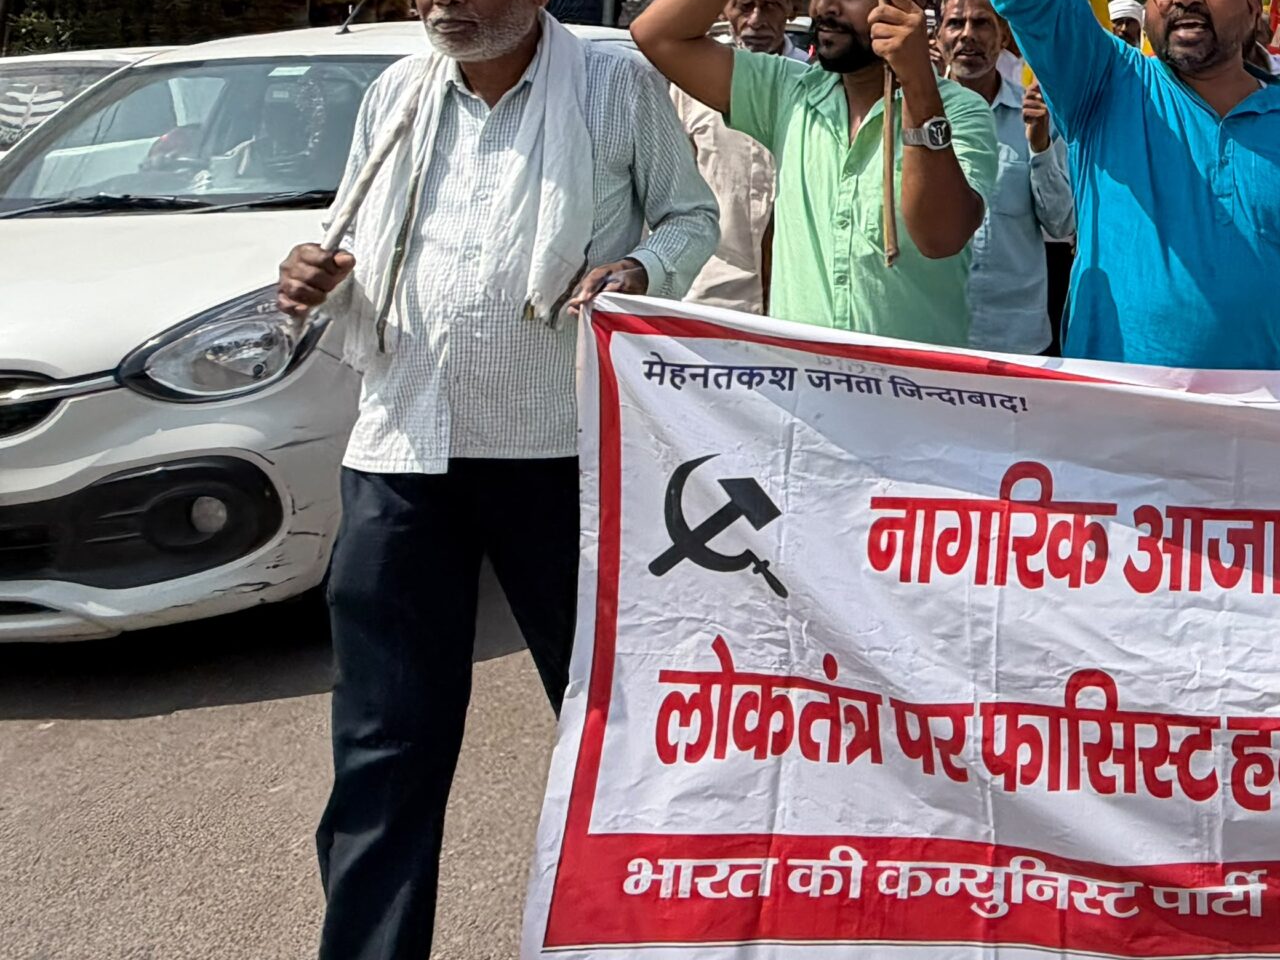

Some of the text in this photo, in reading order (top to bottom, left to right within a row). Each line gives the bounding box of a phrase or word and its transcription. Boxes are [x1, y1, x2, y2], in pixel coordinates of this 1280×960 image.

[643, 351, 798, 392] मेहनतकश
[805, 368, 882, 395] जनता
[867, 460, 1117, 589] नागरिक
[655, 633, 883, 765] लोकतंत्र
[889, 697, 975, 782] पर
[978, 668, 1221, 802] फासिस्ट
[622, 857, 778, 899] भारत
[787, 845, 868, 902] की
[877, 855, 1143, 919] कम्युनिस्ट
[1148, 869, 1267, 917] पार्टी
